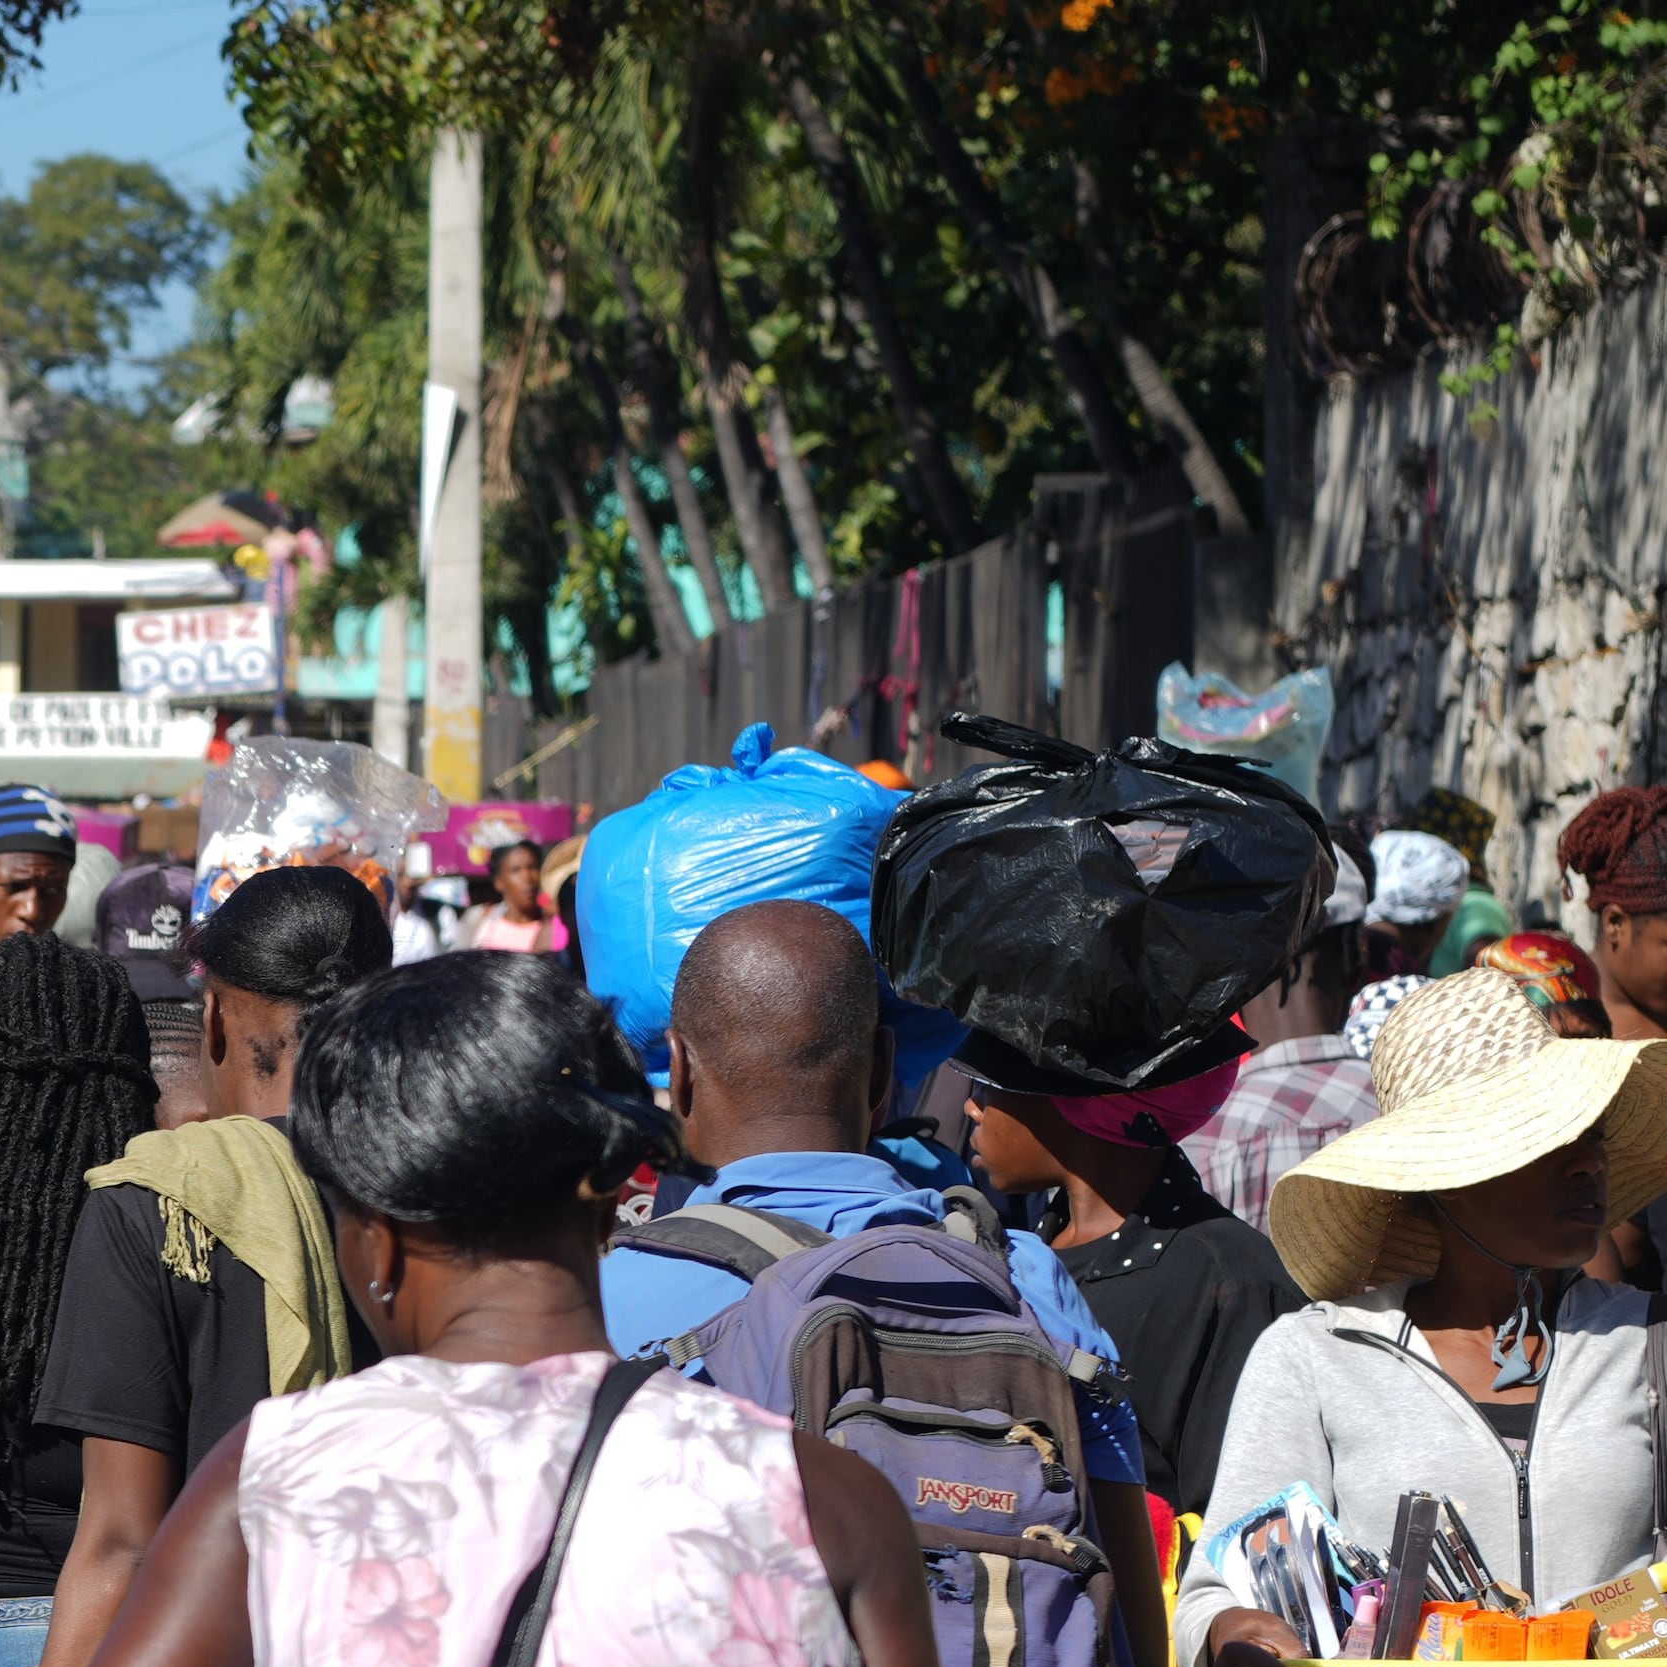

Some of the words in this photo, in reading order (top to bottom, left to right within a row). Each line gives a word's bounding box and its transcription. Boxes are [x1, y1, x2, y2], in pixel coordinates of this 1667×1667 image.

[133, 608, 261, 646] CHEZ
[120, 643, 273, 695] POLO
[9, 700, 35, 720] DE
[1590, 1578, 1634, 1606] IDOLE
[1601, 1594, 1632, 1613] GOLD
[1618, 1637, 1660, 1660] ULTIMATE
